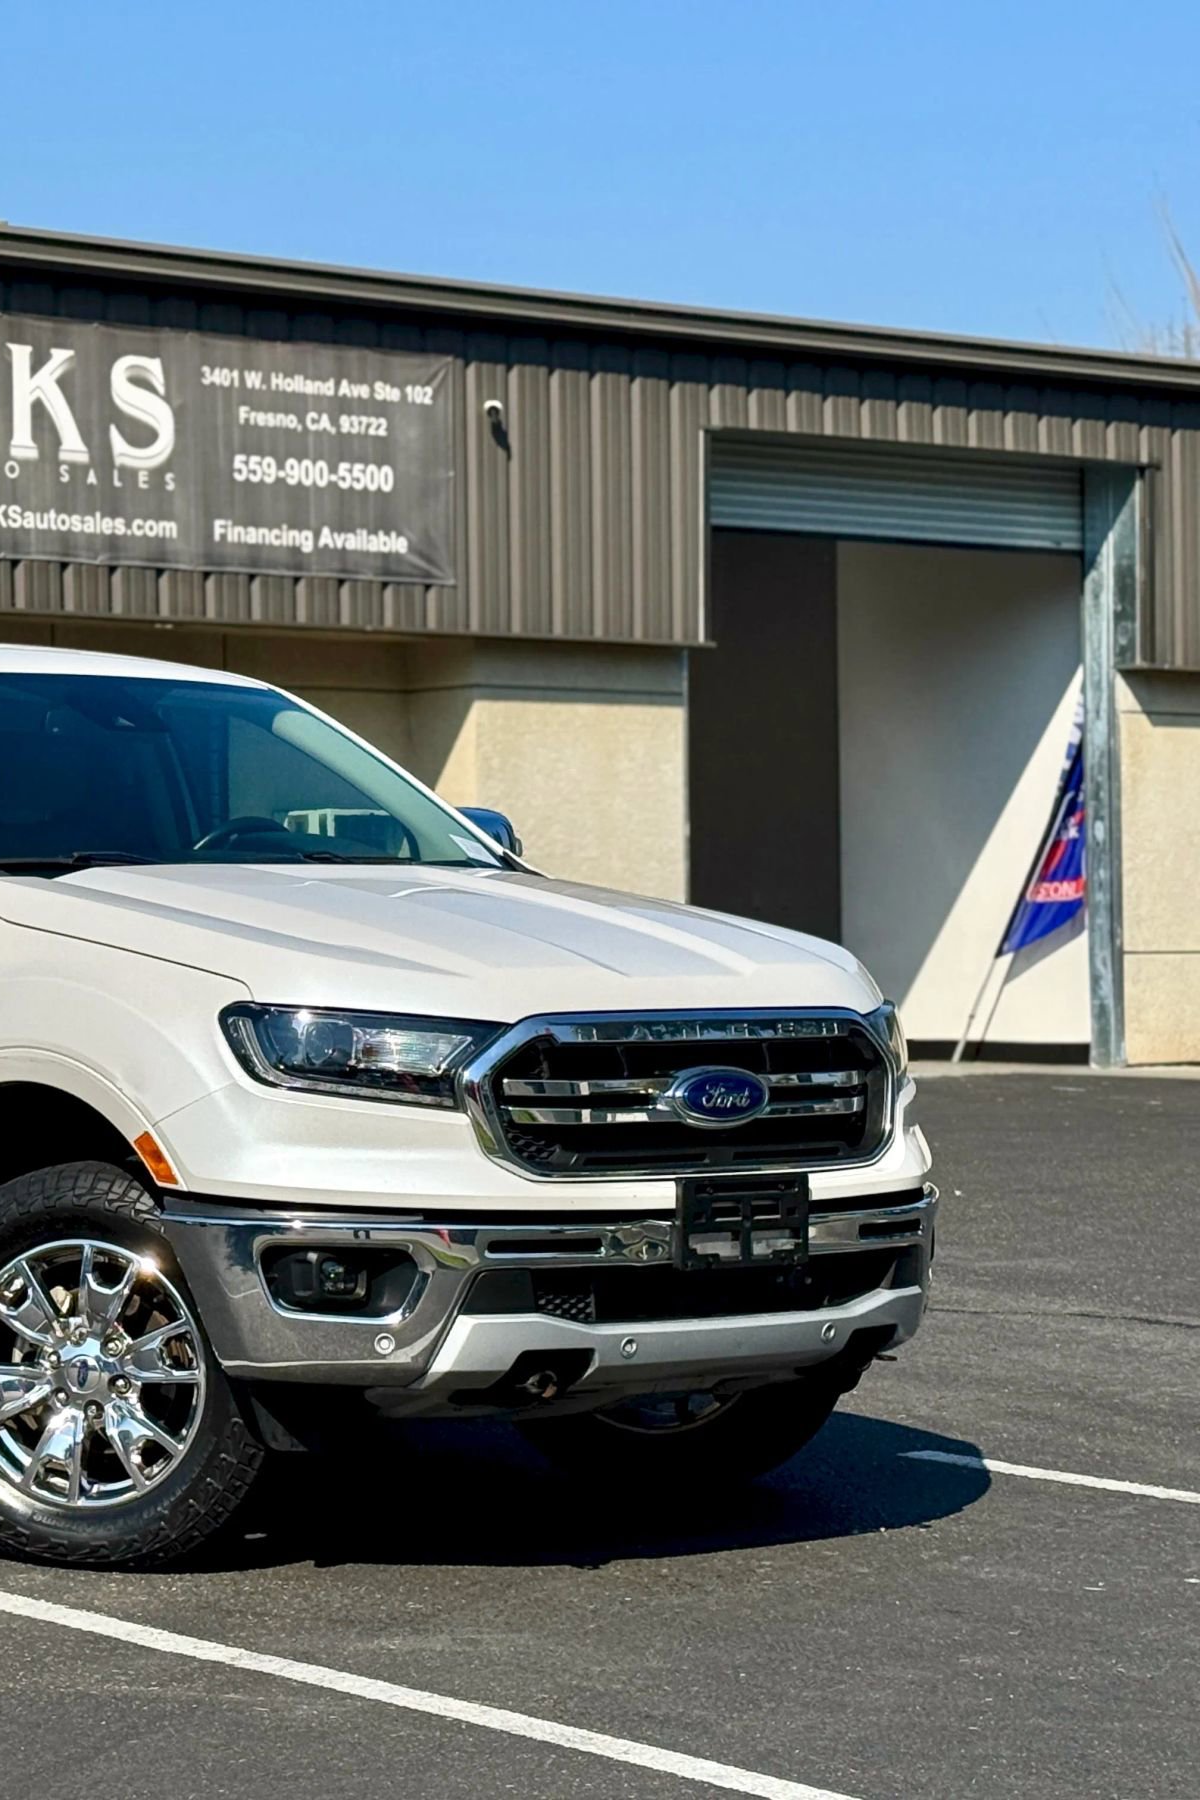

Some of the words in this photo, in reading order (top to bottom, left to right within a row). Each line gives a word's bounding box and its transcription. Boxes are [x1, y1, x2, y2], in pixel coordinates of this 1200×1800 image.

[201, 366, 240, 388] 3401
[244, 371, 266, 391] W.
[271, 373, 334, 396] Holland
[338, 379, 370, 399] Ave
[374, 381, 400, 402] Ste
[405, 385, 433, 405] 102
[239, 406, 302, 431] Fresno,
[306, 412, 336, 434] CA,
[339, 415, 388, 436] 93722
[60, 464, 176, 491] SALES
[233, 455, 394, 492] 559-900-5500
[214, 519, 313, 553] Financing
[319, 526, 408, 554] Available
[702, 1083, 751, 1108] Ford
